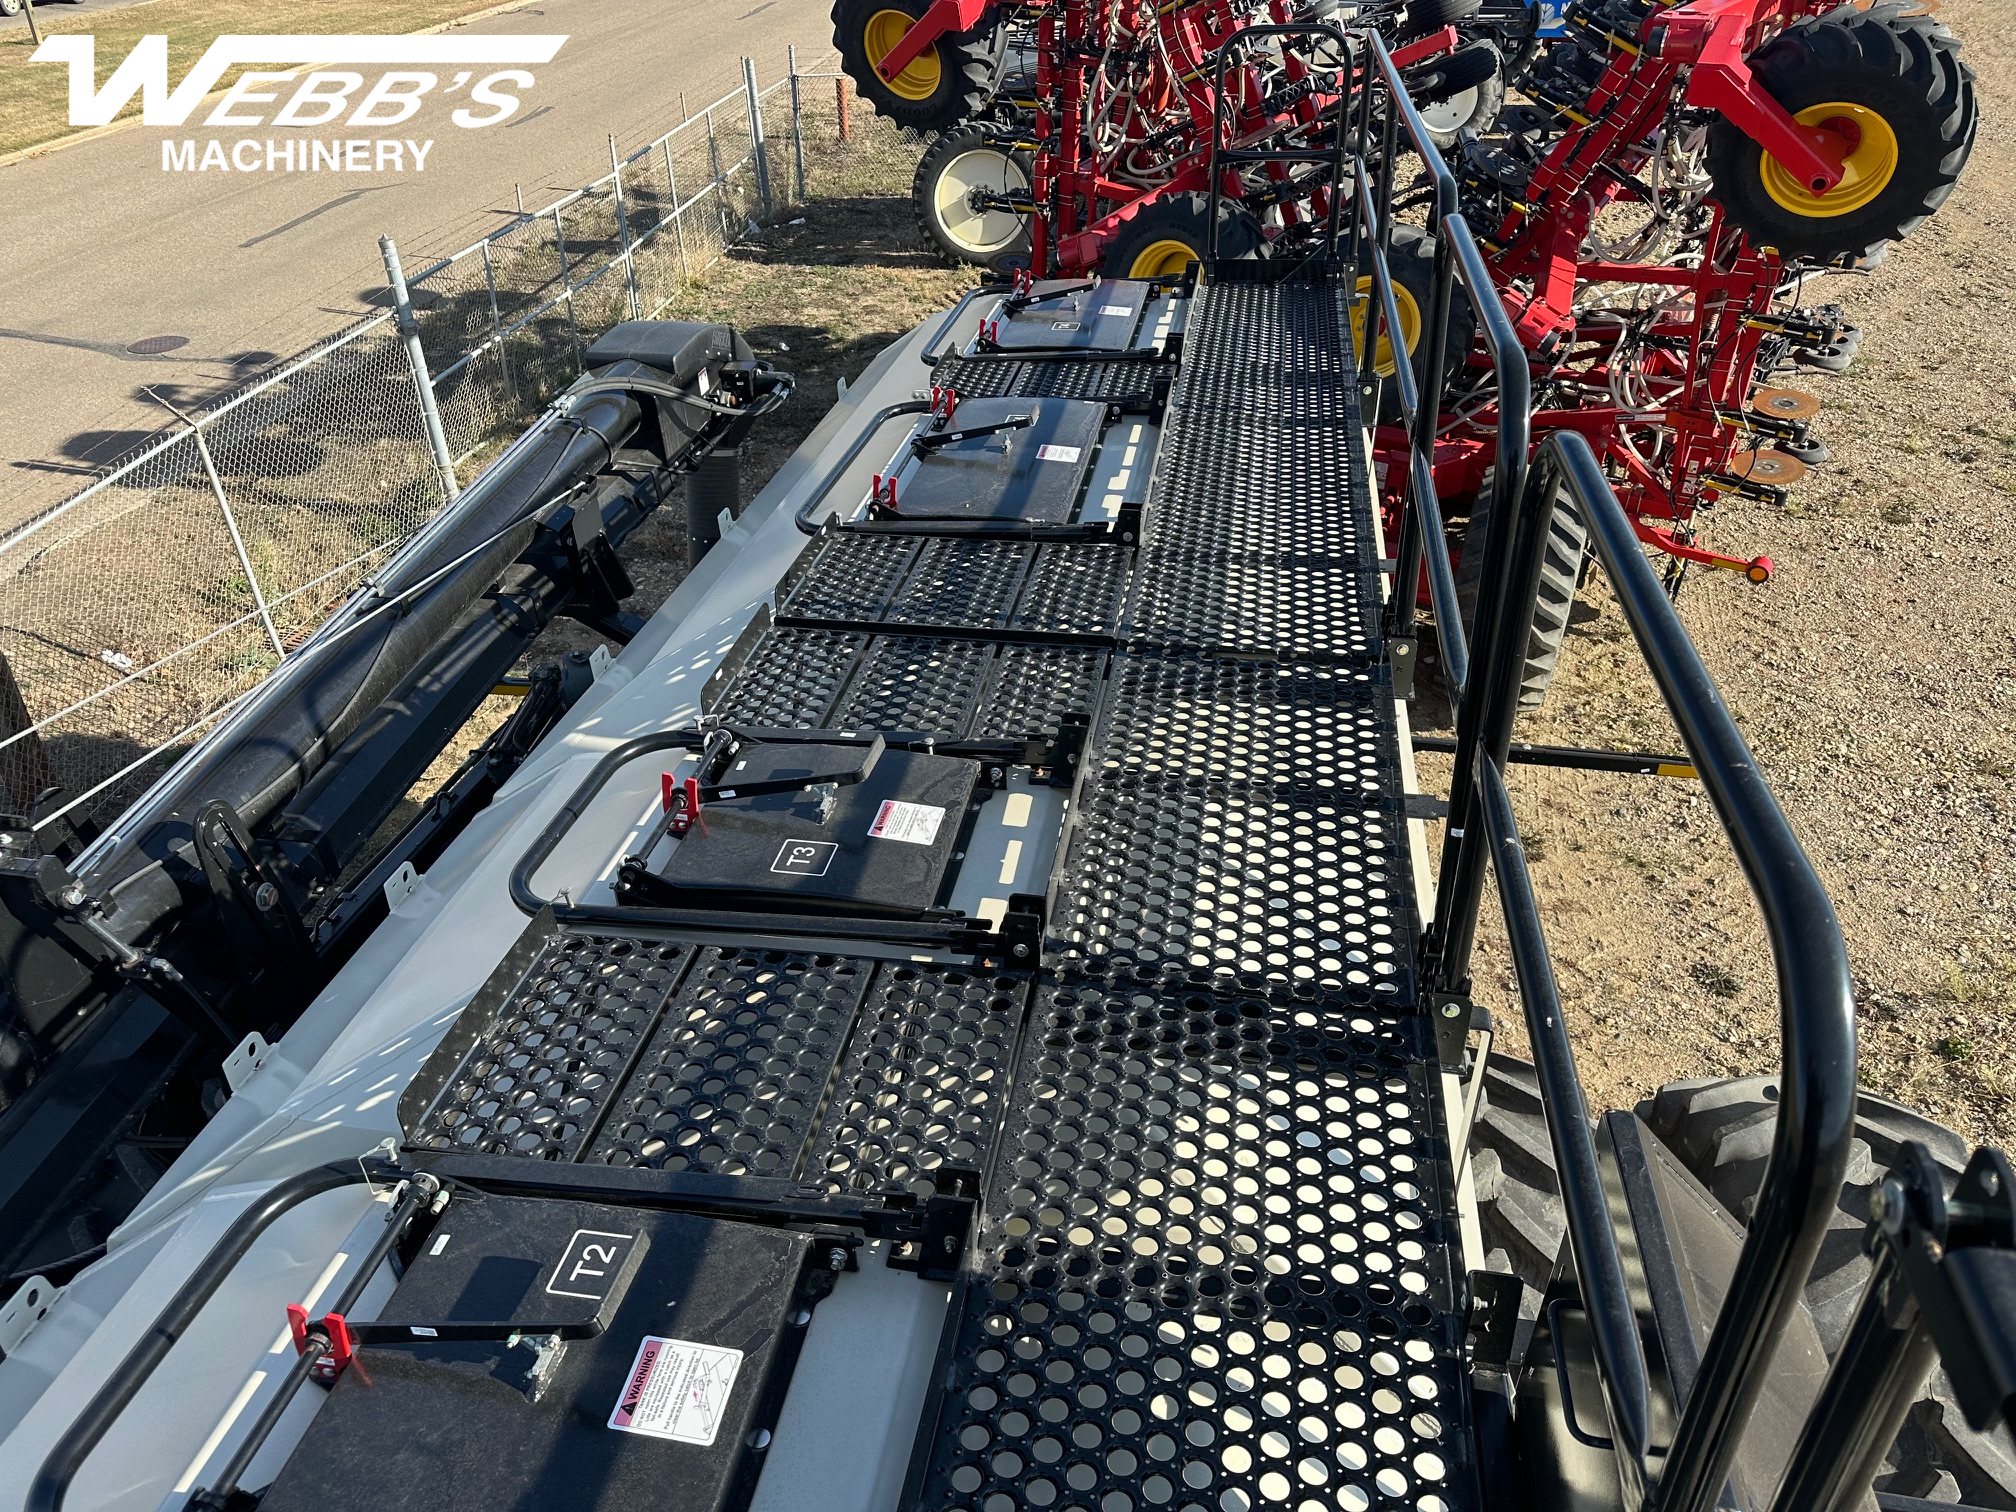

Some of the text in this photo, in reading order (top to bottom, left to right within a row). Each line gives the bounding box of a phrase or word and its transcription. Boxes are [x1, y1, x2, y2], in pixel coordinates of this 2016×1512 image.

[877, 805, 892, 826] WARNING
[786, 847, 815, 867] T3
[569, 1244, 617, 1282] T2
[628, 1350, 656, 1400] WARNING
